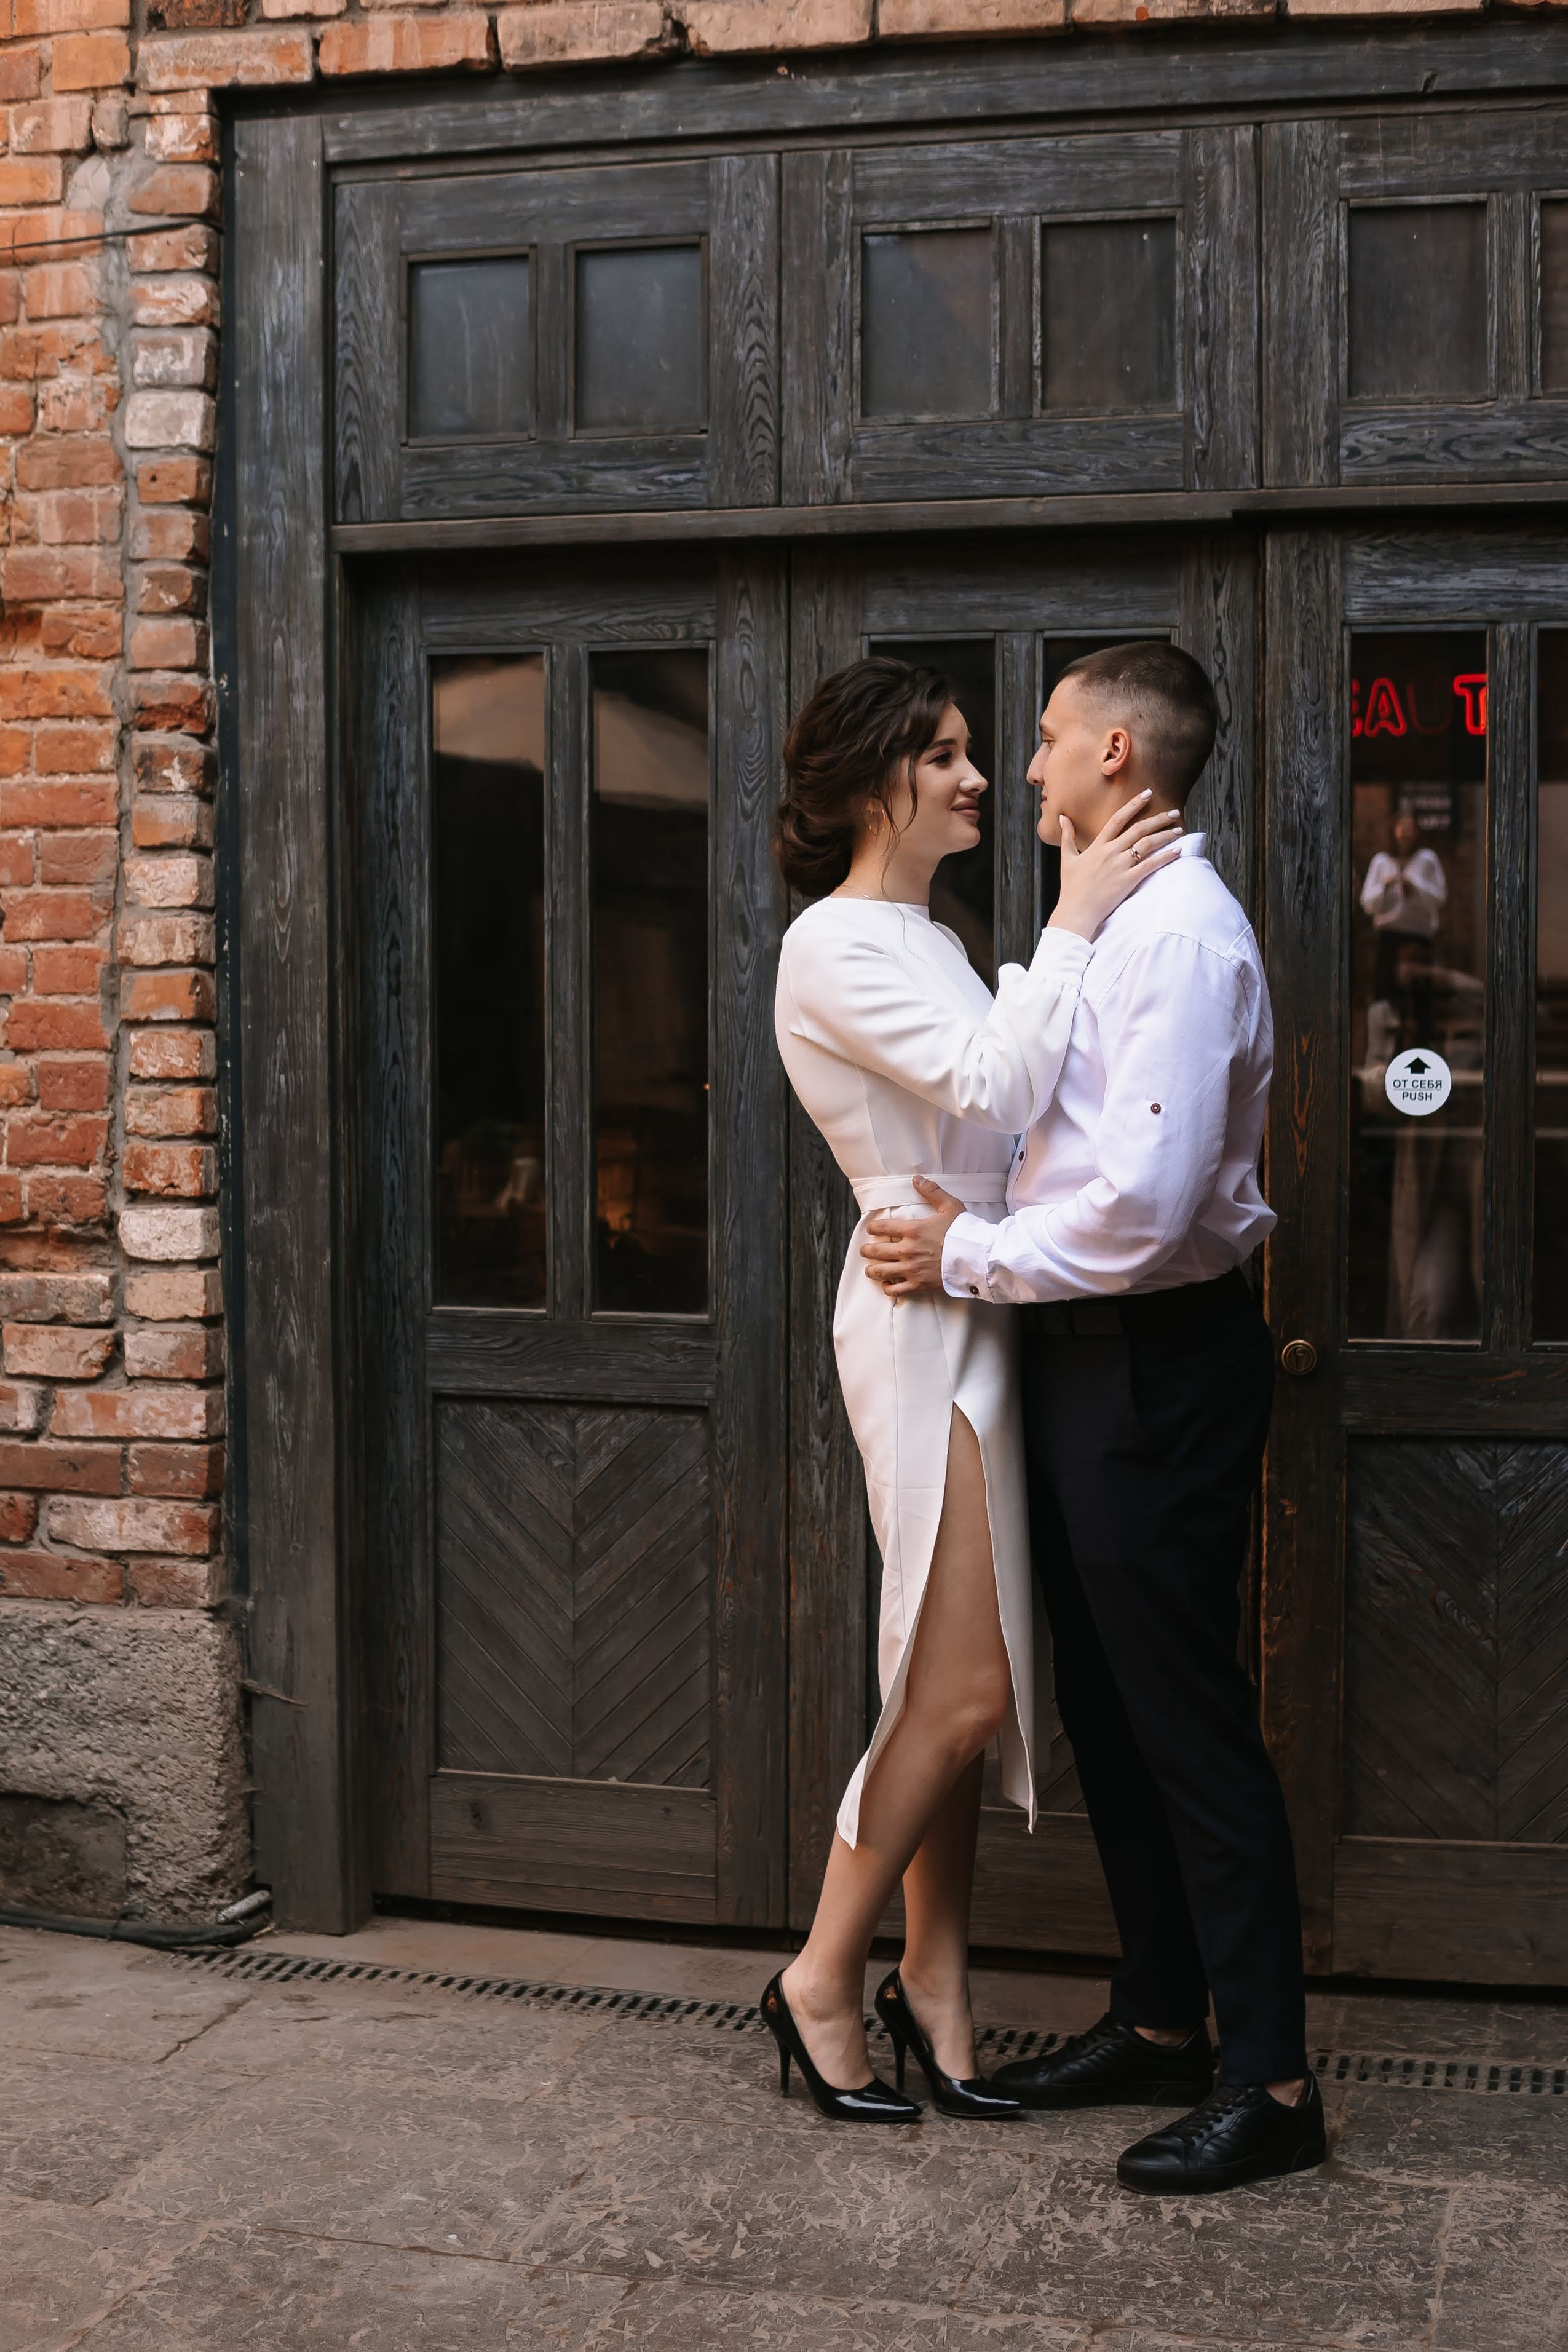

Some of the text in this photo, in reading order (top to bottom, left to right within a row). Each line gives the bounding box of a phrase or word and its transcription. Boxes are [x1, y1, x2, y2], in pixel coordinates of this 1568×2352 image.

[1393, 1079, 1443, 1089] ОТ СЕБЯ
[1402, 1091, 1433, 1101] PUSH
